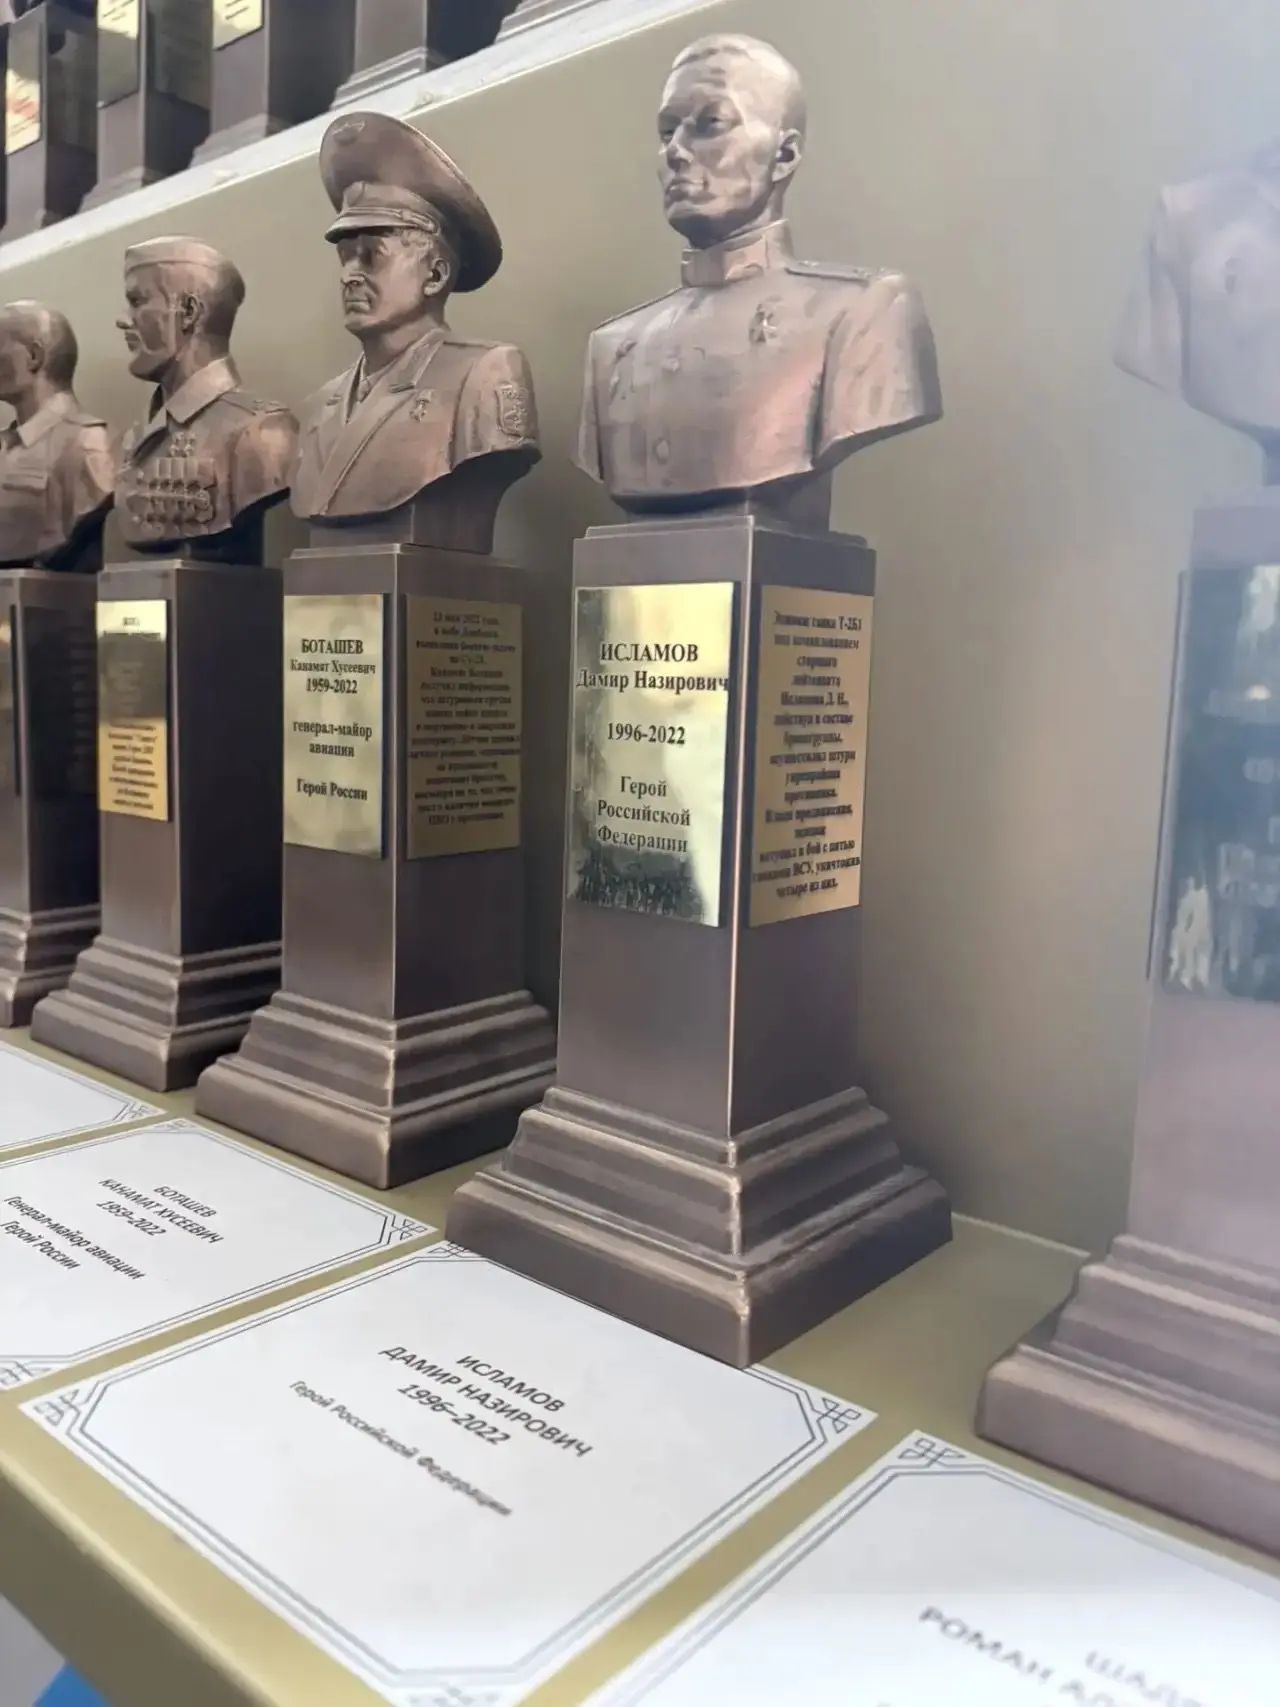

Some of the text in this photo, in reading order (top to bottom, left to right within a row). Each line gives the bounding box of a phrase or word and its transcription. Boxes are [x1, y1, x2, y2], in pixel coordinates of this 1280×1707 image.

[301, 639, 364, 654] БОТАШЕВ
[600, 643, 699, 662] ИСЛАМОВ
[290, 659, 376, 675] Канамат Хусеевич
[306, 678, 358, 694] 1959-2022
[576, 669, 728, 695] Дамир Назирович
[293, 721, 372, 741] генерал-майор
[607, 722, 686, 745] 1996-2022
[309, 742, 355, 757] авиации
[297, 778, 368, 801] Герой России
[620, 776, 667, 799] Герой
[597, 800, 691, 826] Российской
[598, 825, 689, 853] Федерации
[99, 1178, 224, 1244] КАНАМАТ ХУСЕЕВИЧ
[154, 1186, 217, 1218] БОТАШЕВ
[96, 1200, 166, 1236] 1959-2022
[0, 1220, 81, 1270] Герой России
[3, 1196, 145, 1280] Генерал-майор авиации
[456, 1355, 566, 1413] ИСЛАМОВ
[378, 1346, 593, 1457] ДАМИР НАЗИРОВИЧ
[397, 1384, 511, 1445] 1996-2022
[290, 1380, 336, 1408] Герой
[330, 1404, 420, 1459] Российской
[919, 1605, 1054, 1684] РОМАН
